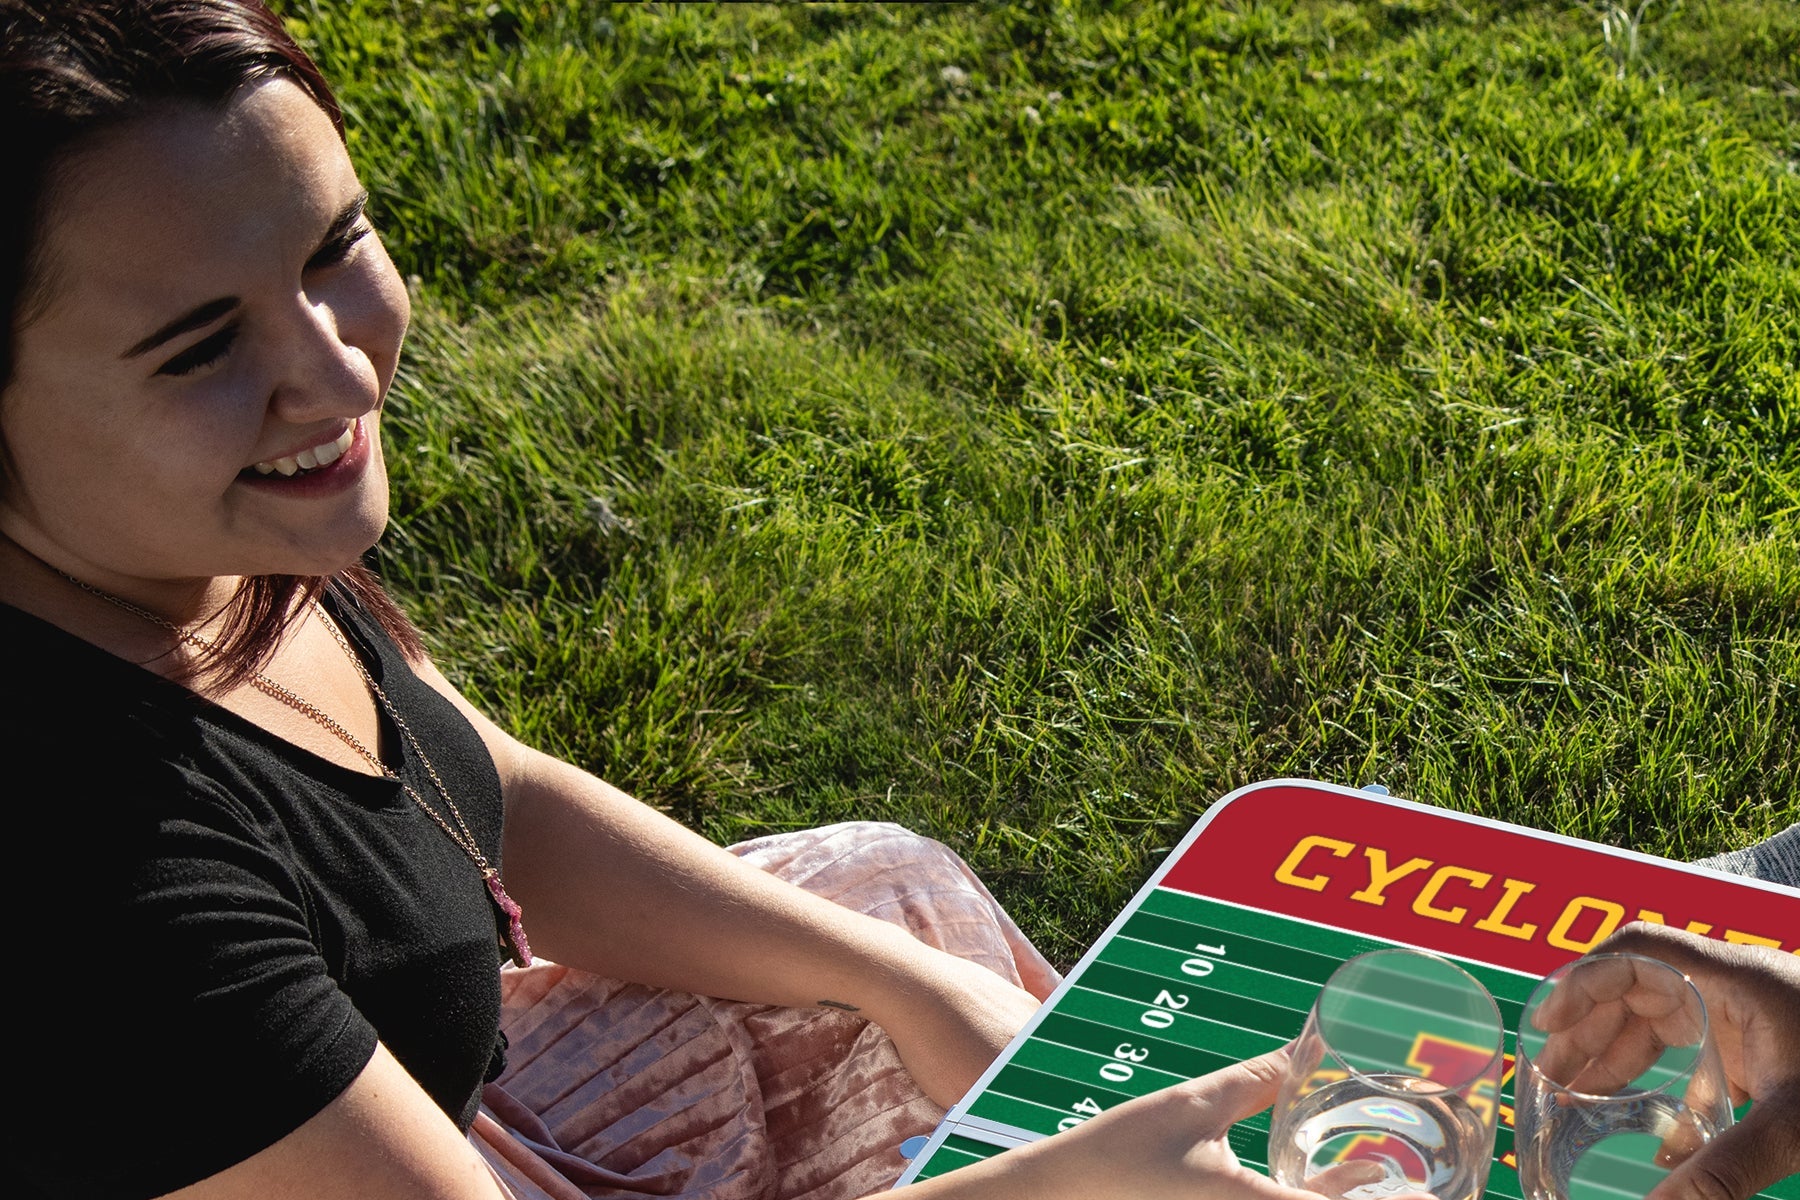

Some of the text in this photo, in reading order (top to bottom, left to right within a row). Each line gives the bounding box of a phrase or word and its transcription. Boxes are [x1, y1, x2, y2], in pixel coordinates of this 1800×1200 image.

[1181, 943, 1226, 977] 10
[1140, 989, 1189, 1029] 20
[1099, 1042, 1149, 1082] 30
